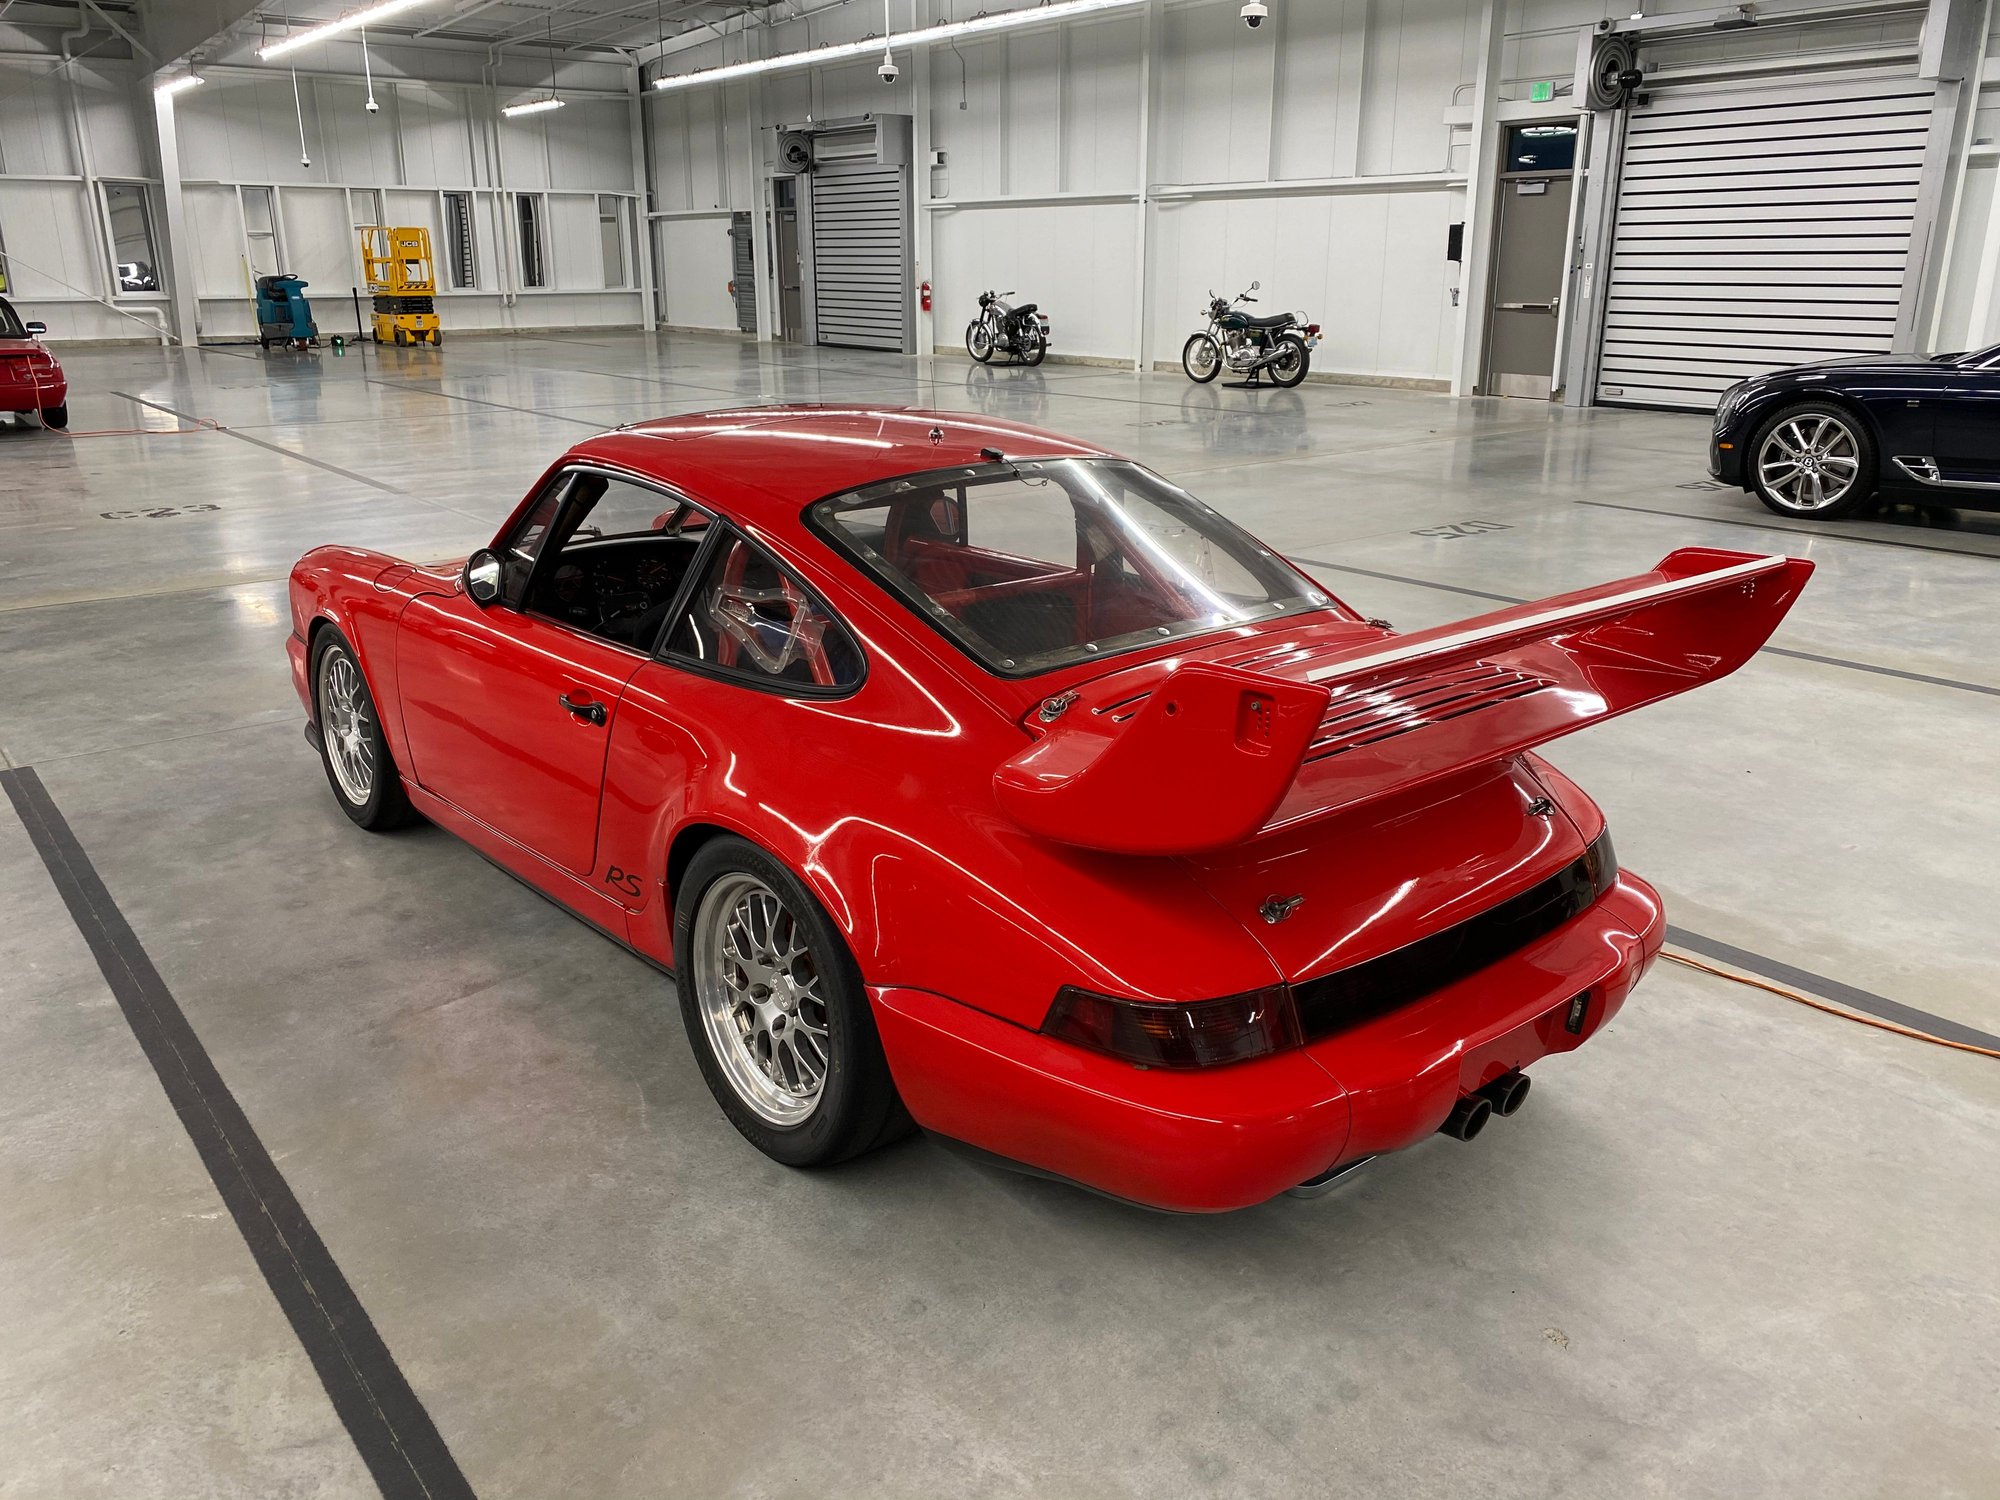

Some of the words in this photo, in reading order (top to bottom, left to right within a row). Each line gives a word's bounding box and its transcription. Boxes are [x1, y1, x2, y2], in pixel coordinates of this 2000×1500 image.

[1675, 479, 1733, 491] 26
[99, 504, 222, 520] C23
[1409, 520, 1516, 540] D25
[604, 864, 643, 897] RS
